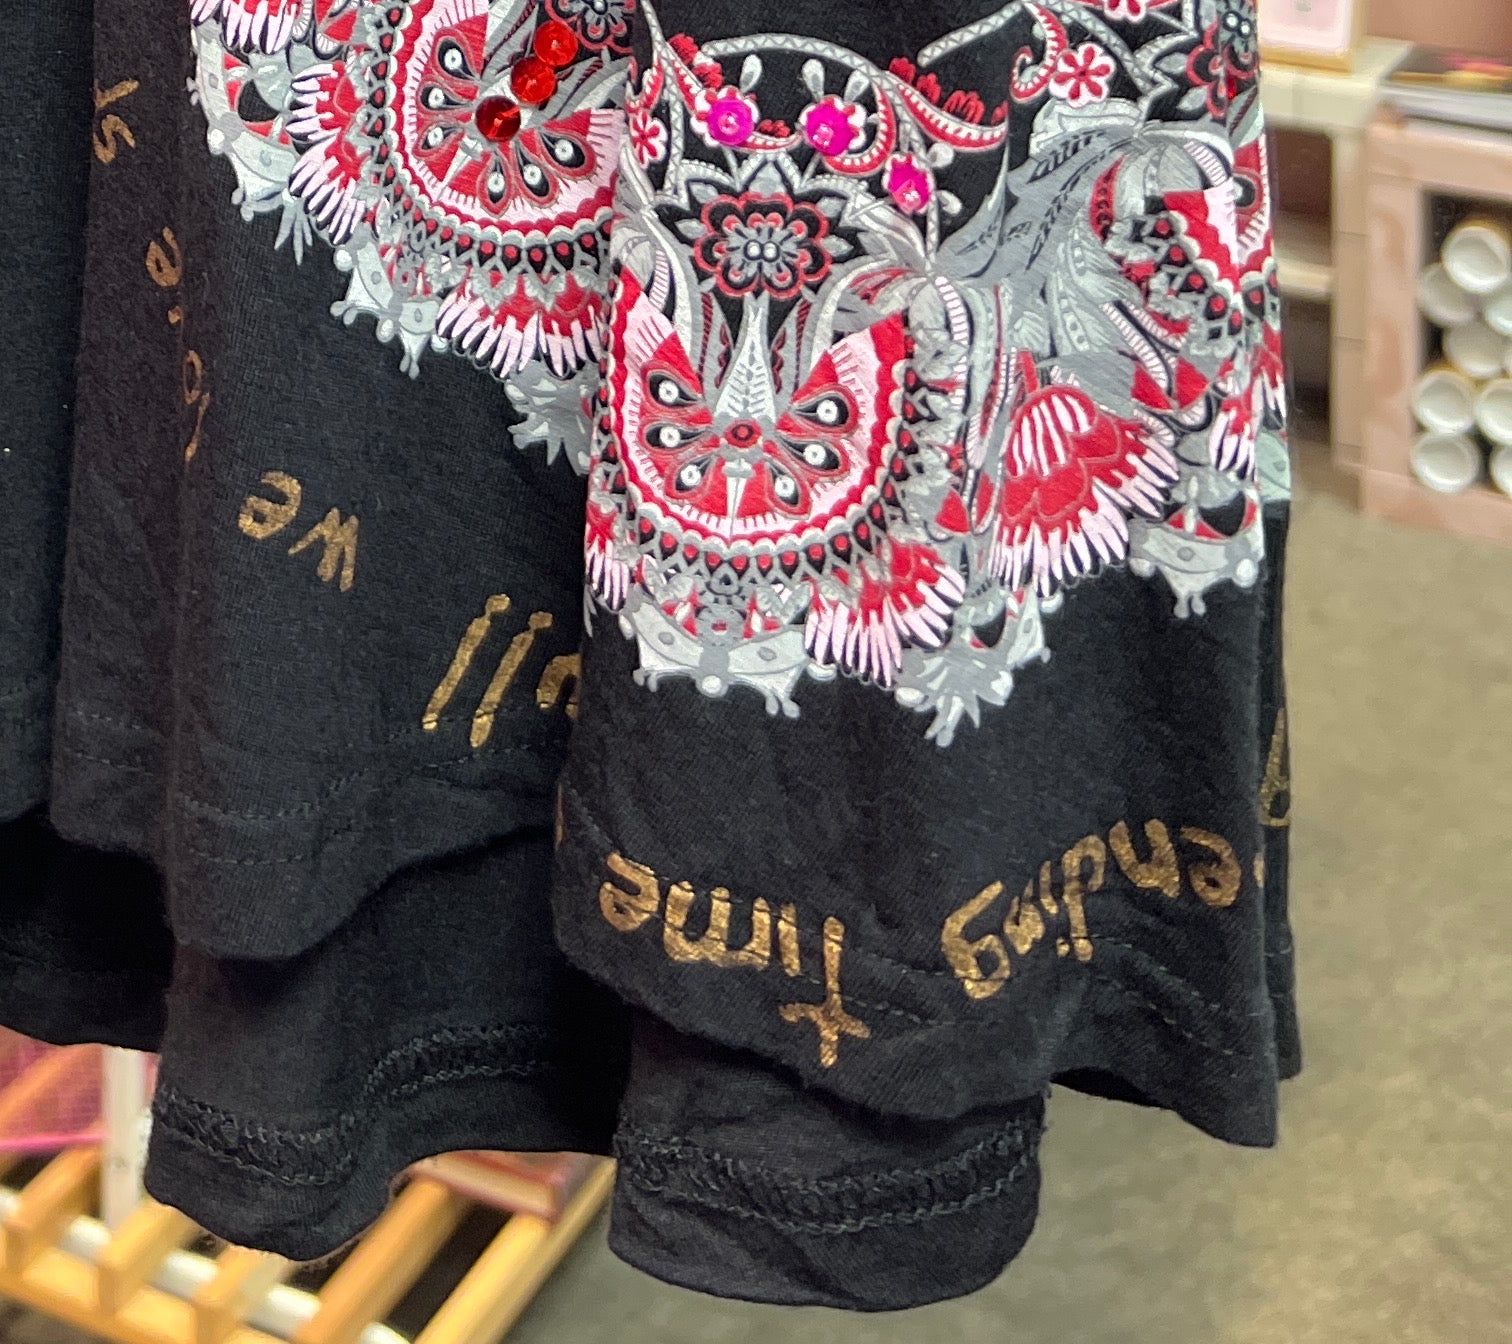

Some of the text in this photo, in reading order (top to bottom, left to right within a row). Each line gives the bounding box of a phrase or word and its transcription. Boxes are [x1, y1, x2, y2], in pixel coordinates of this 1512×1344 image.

[238, 471, 360, 593] we
[598, 818, 1243, 1068] ending time
